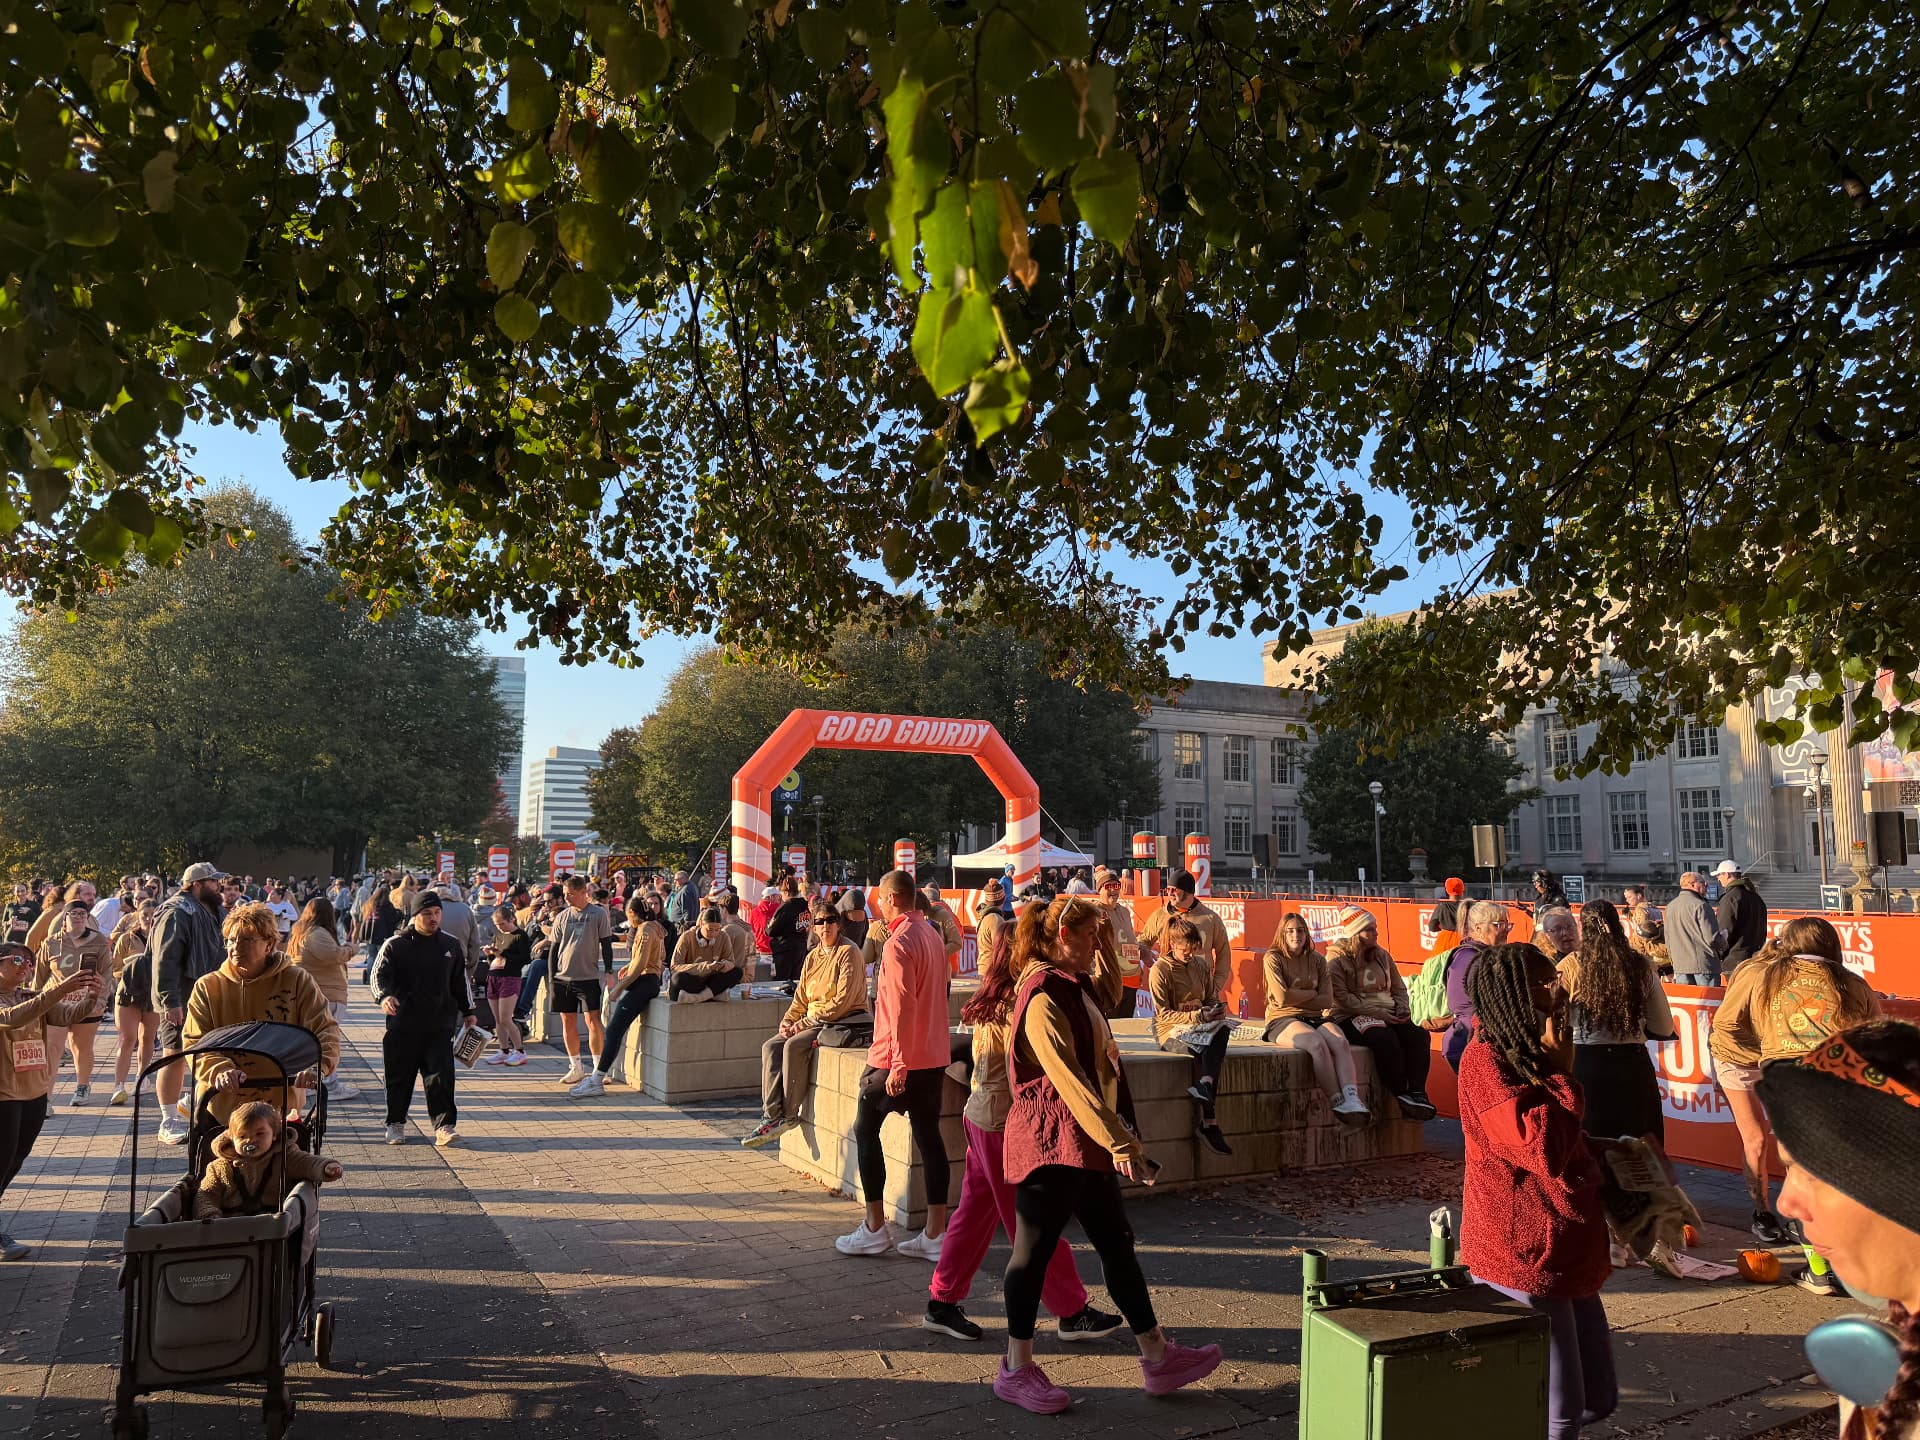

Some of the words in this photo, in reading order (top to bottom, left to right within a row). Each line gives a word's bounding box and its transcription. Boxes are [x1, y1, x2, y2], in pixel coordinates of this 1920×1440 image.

[817, 715, 856, 742] GO
[854, 717, 892, 743] GO
[893, 719, 990, 748] GOURDY
[1132, 842, 1156, 855] MILE
[1187, 843, 1210, 856] MILE
[489, 853, 508, 883] GO
[1191, 858, 1210, 896] 2
[1843, 953, 1865, 966] UN
[1136, 993, 1153, 1012] UN
